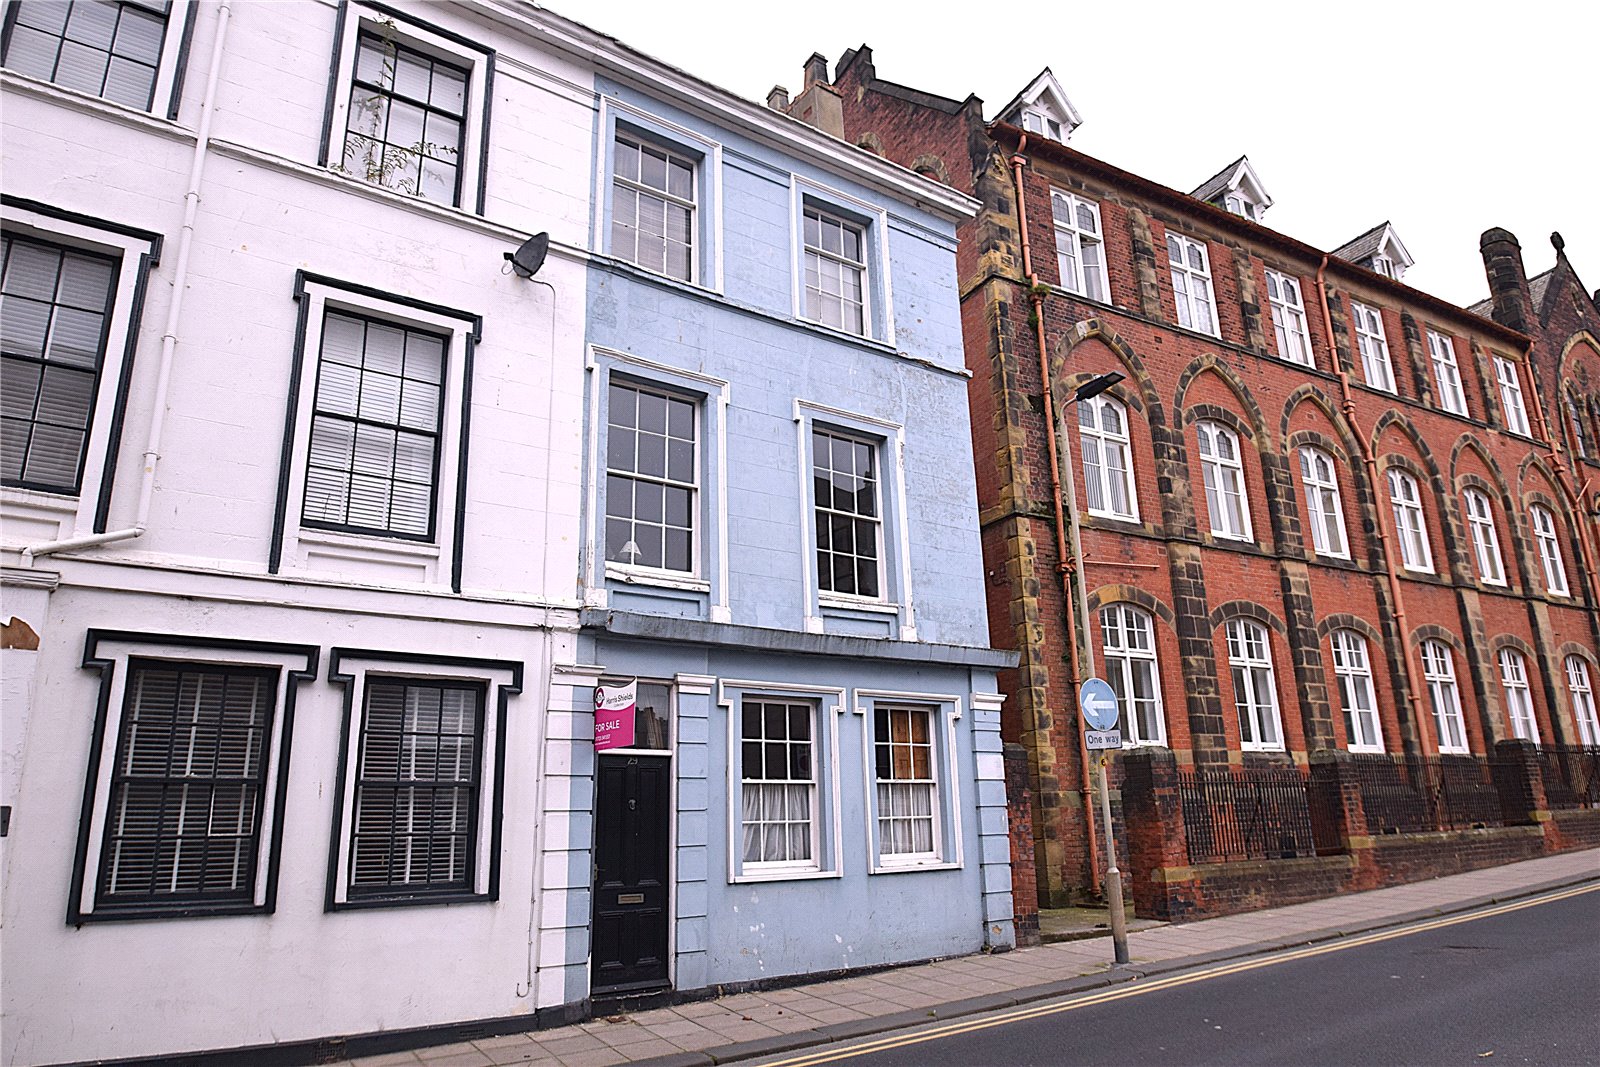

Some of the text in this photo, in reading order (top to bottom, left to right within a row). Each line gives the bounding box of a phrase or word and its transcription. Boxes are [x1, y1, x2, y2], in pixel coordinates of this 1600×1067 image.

[606, 697, 617, 705] Harris
[617, 693, 633, 702] Shields
[595, 720, 620, 732] FOR SALE
[1088, 735, 1119, 744] One way
